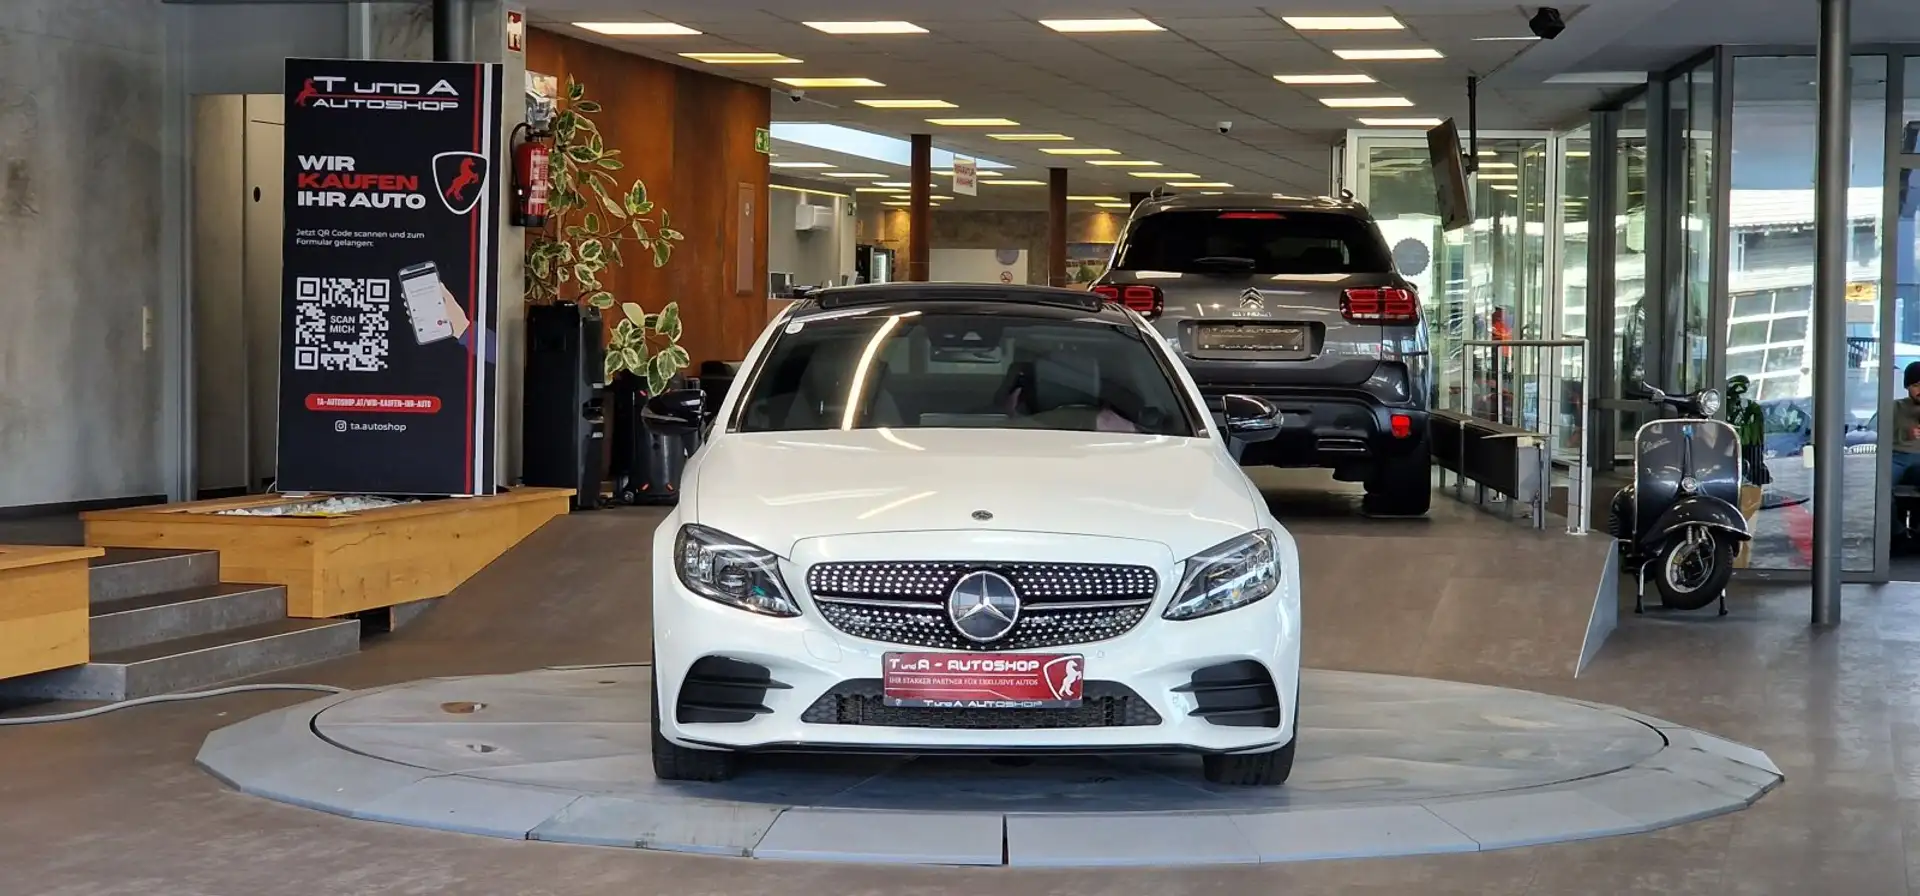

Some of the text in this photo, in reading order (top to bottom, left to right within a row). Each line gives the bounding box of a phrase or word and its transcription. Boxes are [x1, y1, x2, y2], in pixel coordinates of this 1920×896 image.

[313, 76, 346, 92] T
[427, 79, 460, 96] A
[313, 98, 459, 112] AUTOSHOP
[298, 155, 355, 171] WIR
[298, 173, 418, 190] KAUFEN
[298, 191, 426, 209] IHR AUTO
[296, 229, 316, 237] Jetzt
[317, 229, 330, 237] QR
[331, 229, 352, 237] Code
[353, 230, 388, 238] scannen
[389, 231, 406, 239] und
[330, 325, 355, 333] MICH
[350, 422, 407, 432] ta.autoshop
[948, 660, 1040, 671] AUTOSHOP
[889, 676, 902, 684] IHR
[902, 677, 931, 685] STARKER
[932, 677, 963, 686] PARTNER
[964, 677, 977, 686] FÜR
[979, 678, 1014, 686] EXKLUSIVE
[967, 700, 1042, 708] AUTOSHOP
